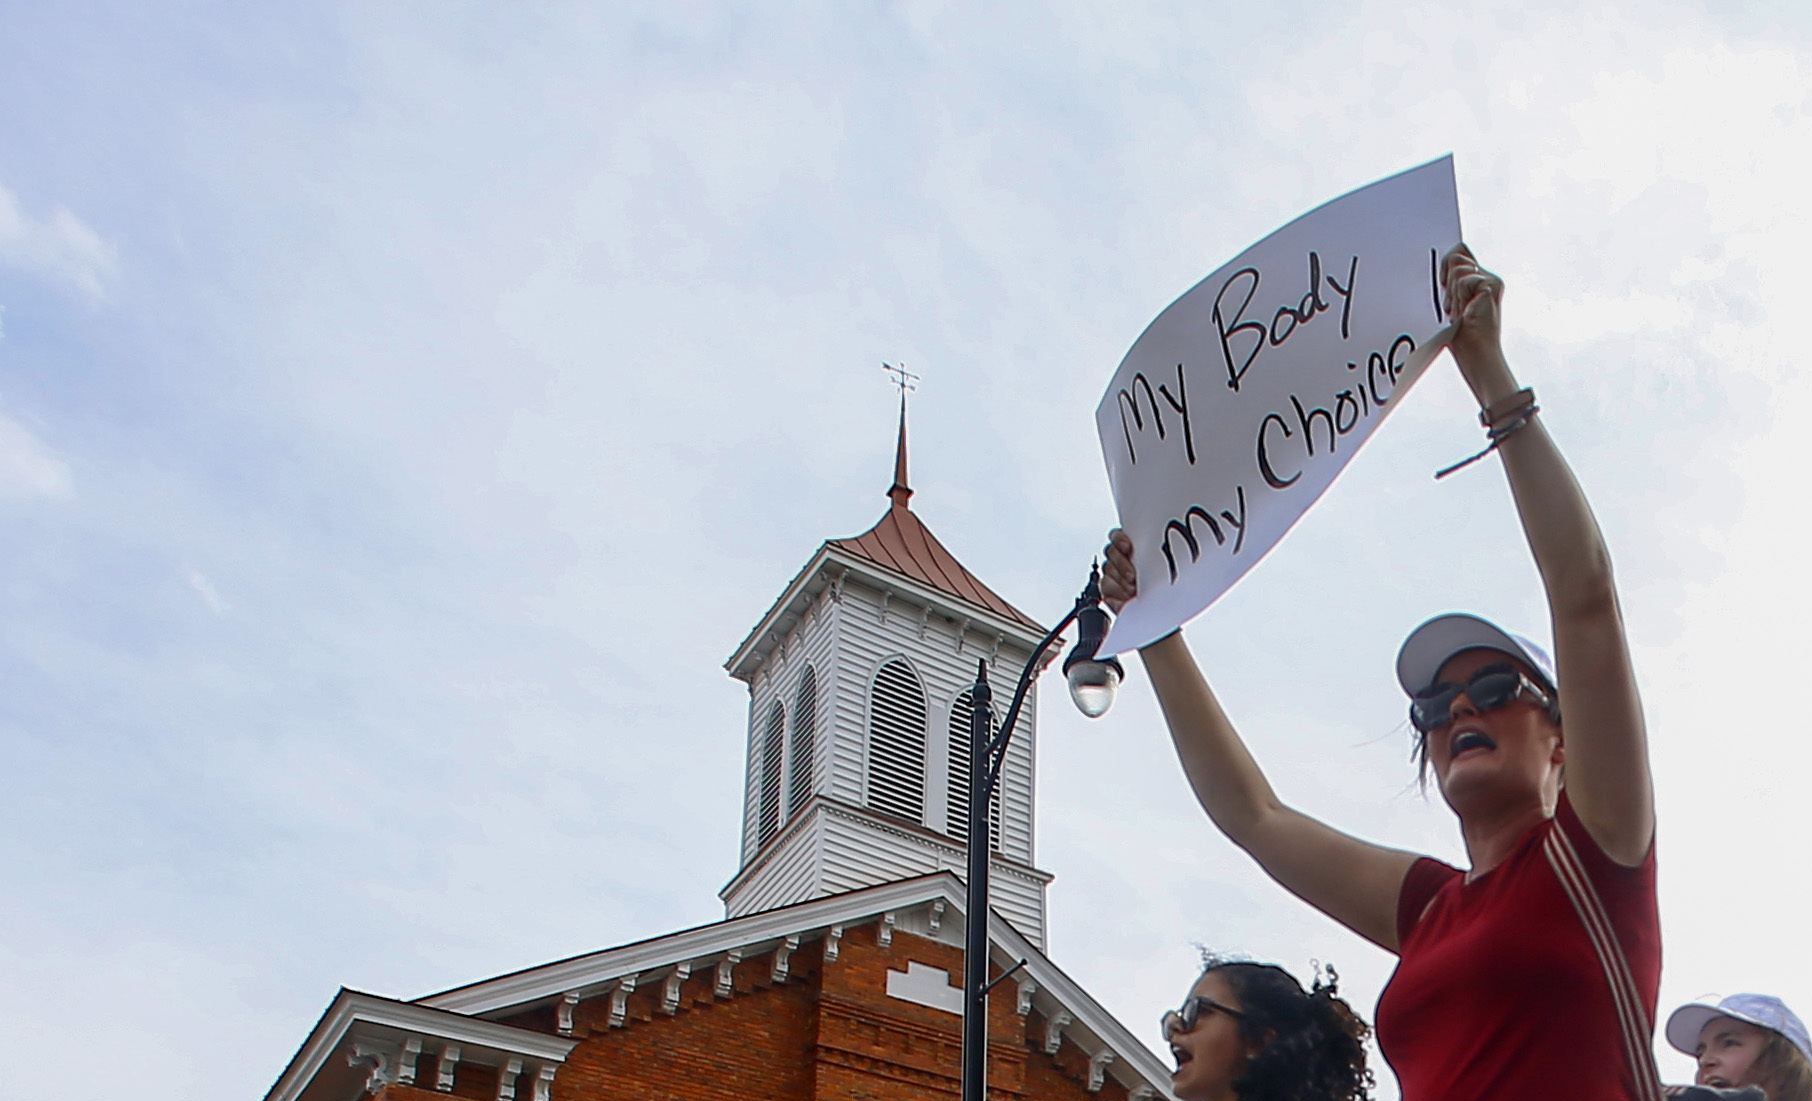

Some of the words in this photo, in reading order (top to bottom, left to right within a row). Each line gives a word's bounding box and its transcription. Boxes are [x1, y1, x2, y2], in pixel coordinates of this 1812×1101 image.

[1117, 363, 1196, 465] My
[1211, 251, 1359, 392] Body
[1161, 485, 1246, 585] My
[1256, 334, 1417, 489] Choice
